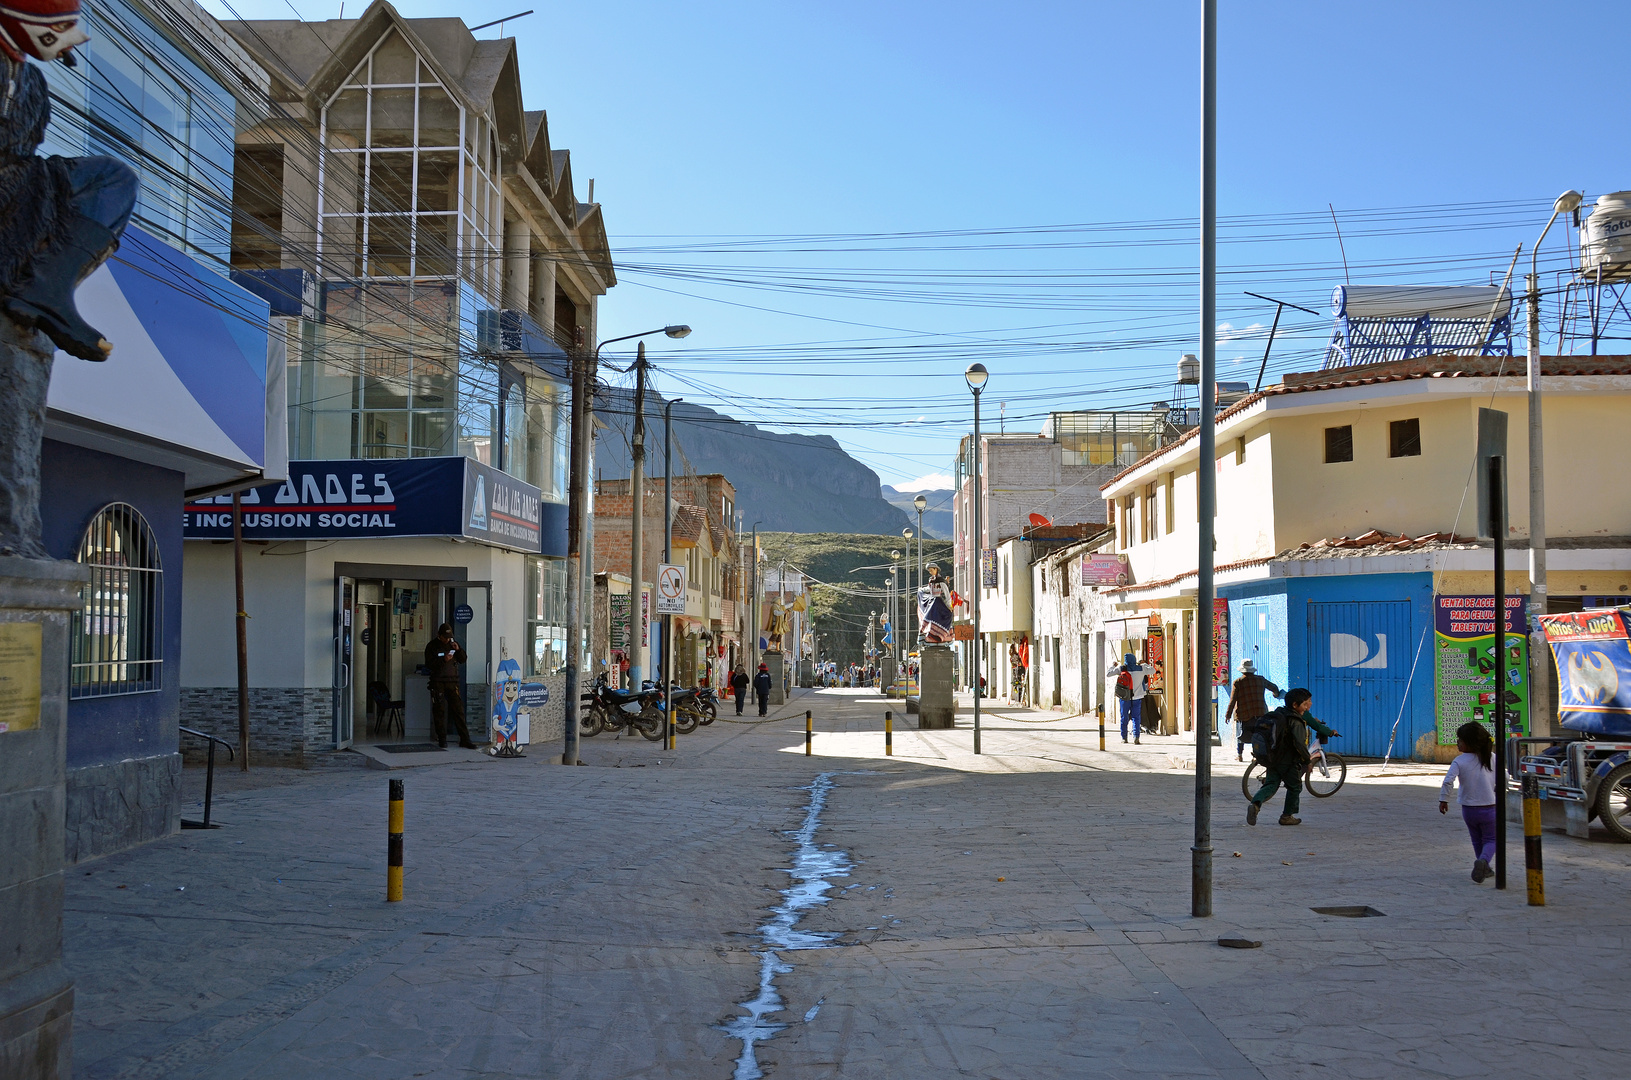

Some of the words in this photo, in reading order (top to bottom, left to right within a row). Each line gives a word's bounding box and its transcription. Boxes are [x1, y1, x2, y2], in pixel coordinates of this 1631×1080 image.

[274, 473, 395, 504] ANDES
[196, 513, 311, 528] INCUSION
[318, 513, 396, 528] SOCIAL
[1440, 598, 1464, 609] VENTA
[1465, 598, 1476, 608] DE
[1475, 597, 1521, 609] ACCERIOS
[1450, 610, 1470, 620] PARA
[1451, 622, 1478, 633] TABLET
[1543, 619, 1574, 636] MOTOS
[1587, 614, 1617, 635] LUGO
